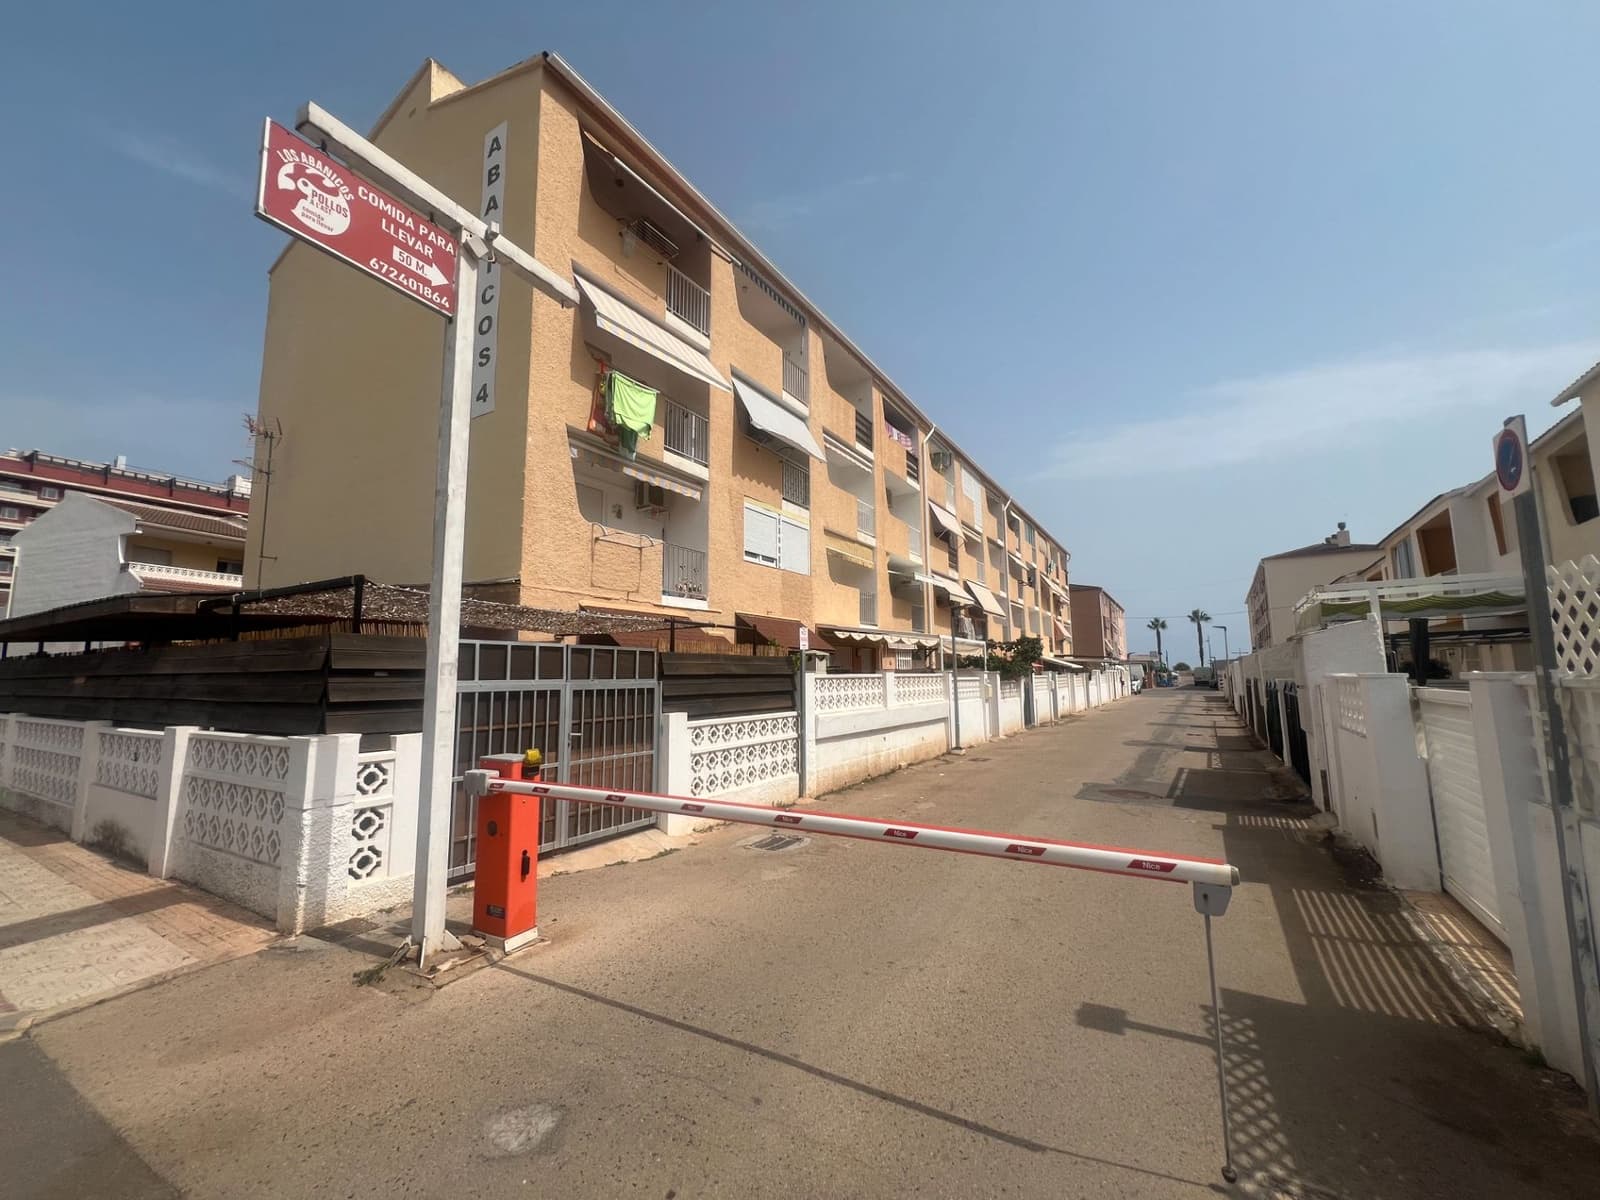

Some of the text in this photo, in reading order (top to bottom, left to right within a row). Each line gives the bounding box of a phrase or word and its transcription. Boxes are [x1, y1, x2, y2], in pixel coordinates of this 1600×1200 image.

[276, 148, 355, 201] LOS ABANICOS
[311, 188, 349, 218] POLLOS
[357, 185, 455, 256] COMIDA PARA
[381, 217, 433, 260] LLEVAR
[398, 250, 413, 267] 50
[369, 257, 450, 308] 672401864
[475, 135, 502, 403] ABAICOS 4
